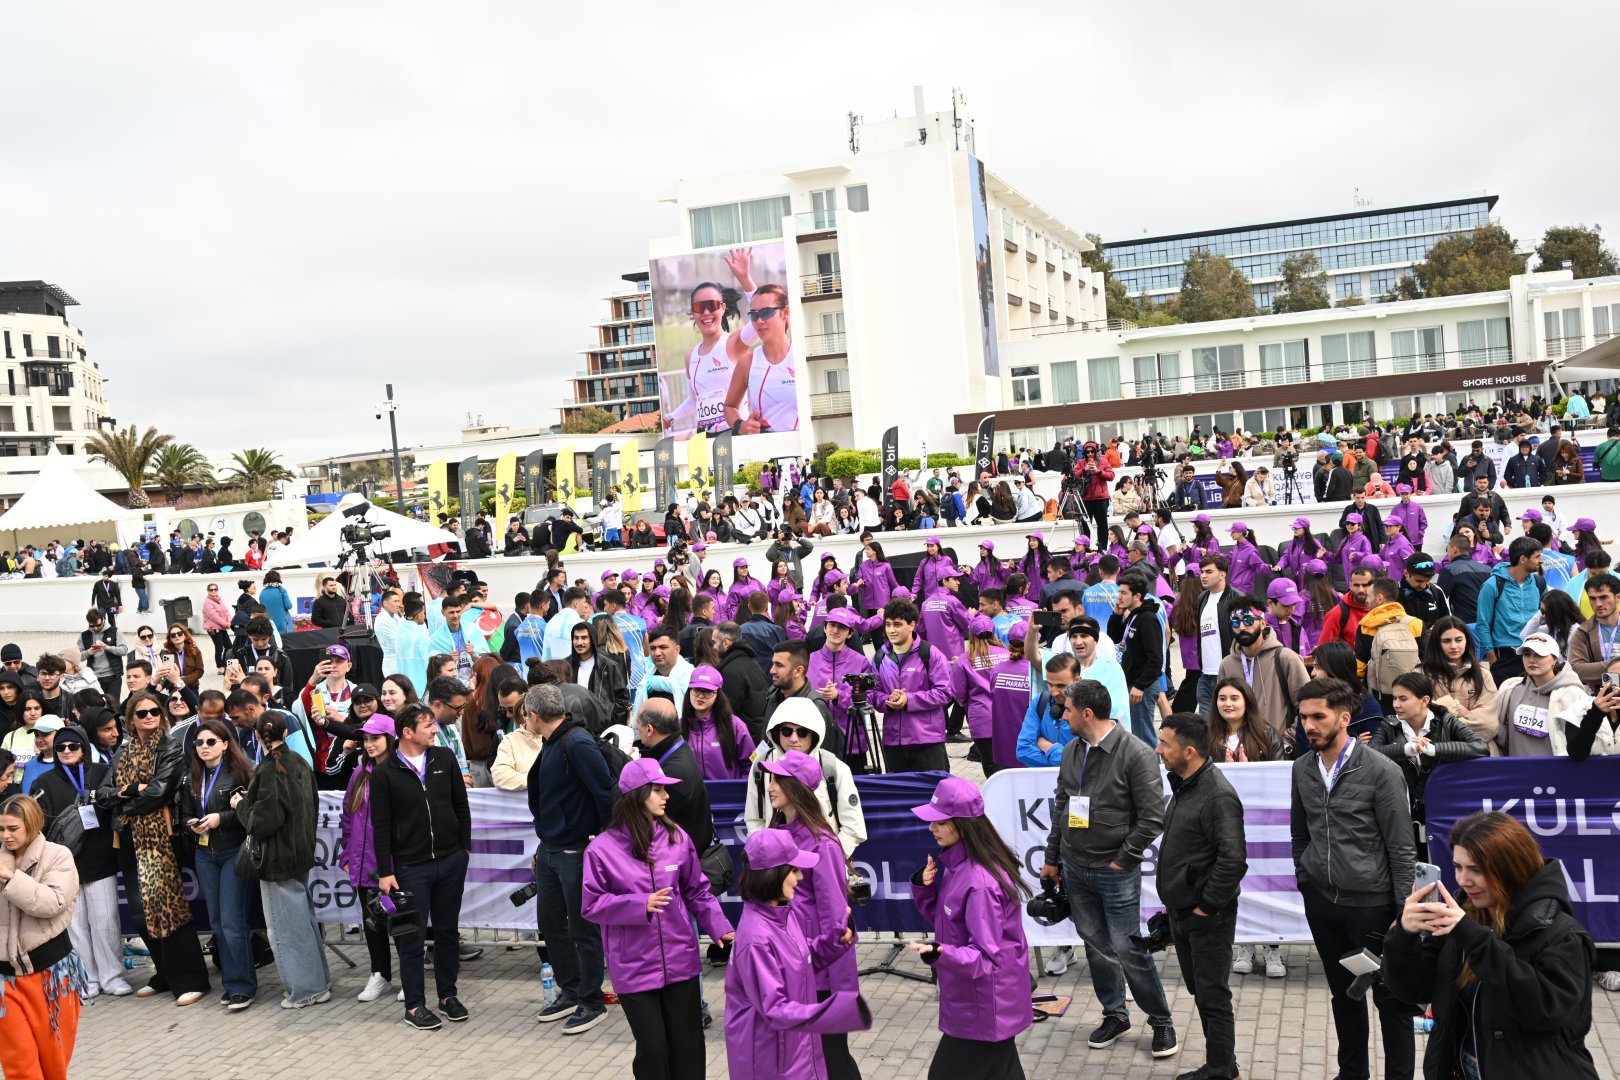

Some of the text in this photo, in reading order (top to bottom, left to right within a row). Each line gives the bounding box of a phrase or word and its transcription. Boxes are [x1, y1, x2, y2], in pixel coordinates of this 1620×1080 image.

[1462, 374, 1527, 388] SHORE HOUSE
[886, 443, 896, 462] bir
[980, 433, 990, 454] bir
[1273, 471, 1312, 481] KÜƏYƏ
[1518, 715, 1544, 729] 13194
[1482, 786, 1620, 837] ÜL
[309, 879, 358, 909] GƏ
